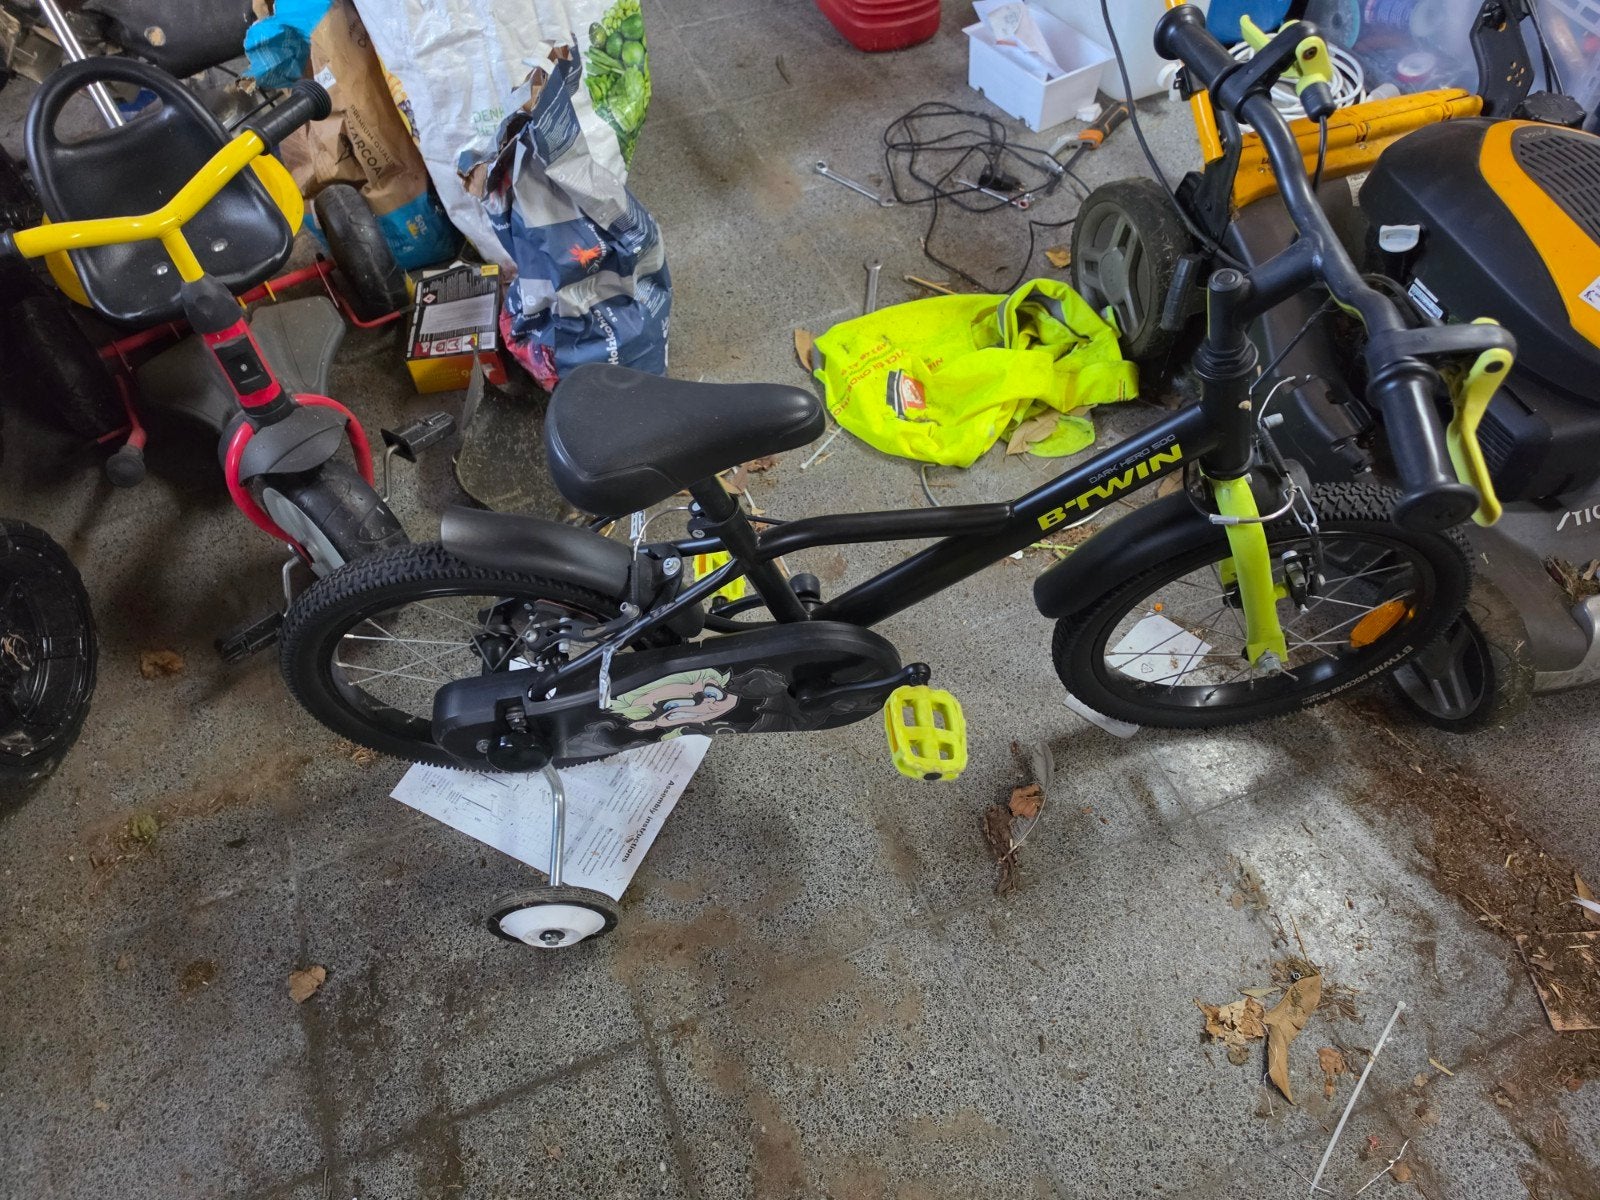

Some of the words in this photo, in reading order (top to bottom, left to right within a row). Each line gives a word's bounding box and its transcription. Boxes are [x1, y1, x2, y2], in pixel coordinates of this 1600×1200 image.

[346, 120, 386, 181] ARCOA
[1088, 463, 1119, 484] DARK
[1119, 447, 1151, 469] HERO
[1151, 433, 1176, 450] 500
[650, 779, 675, 815] Assembly
